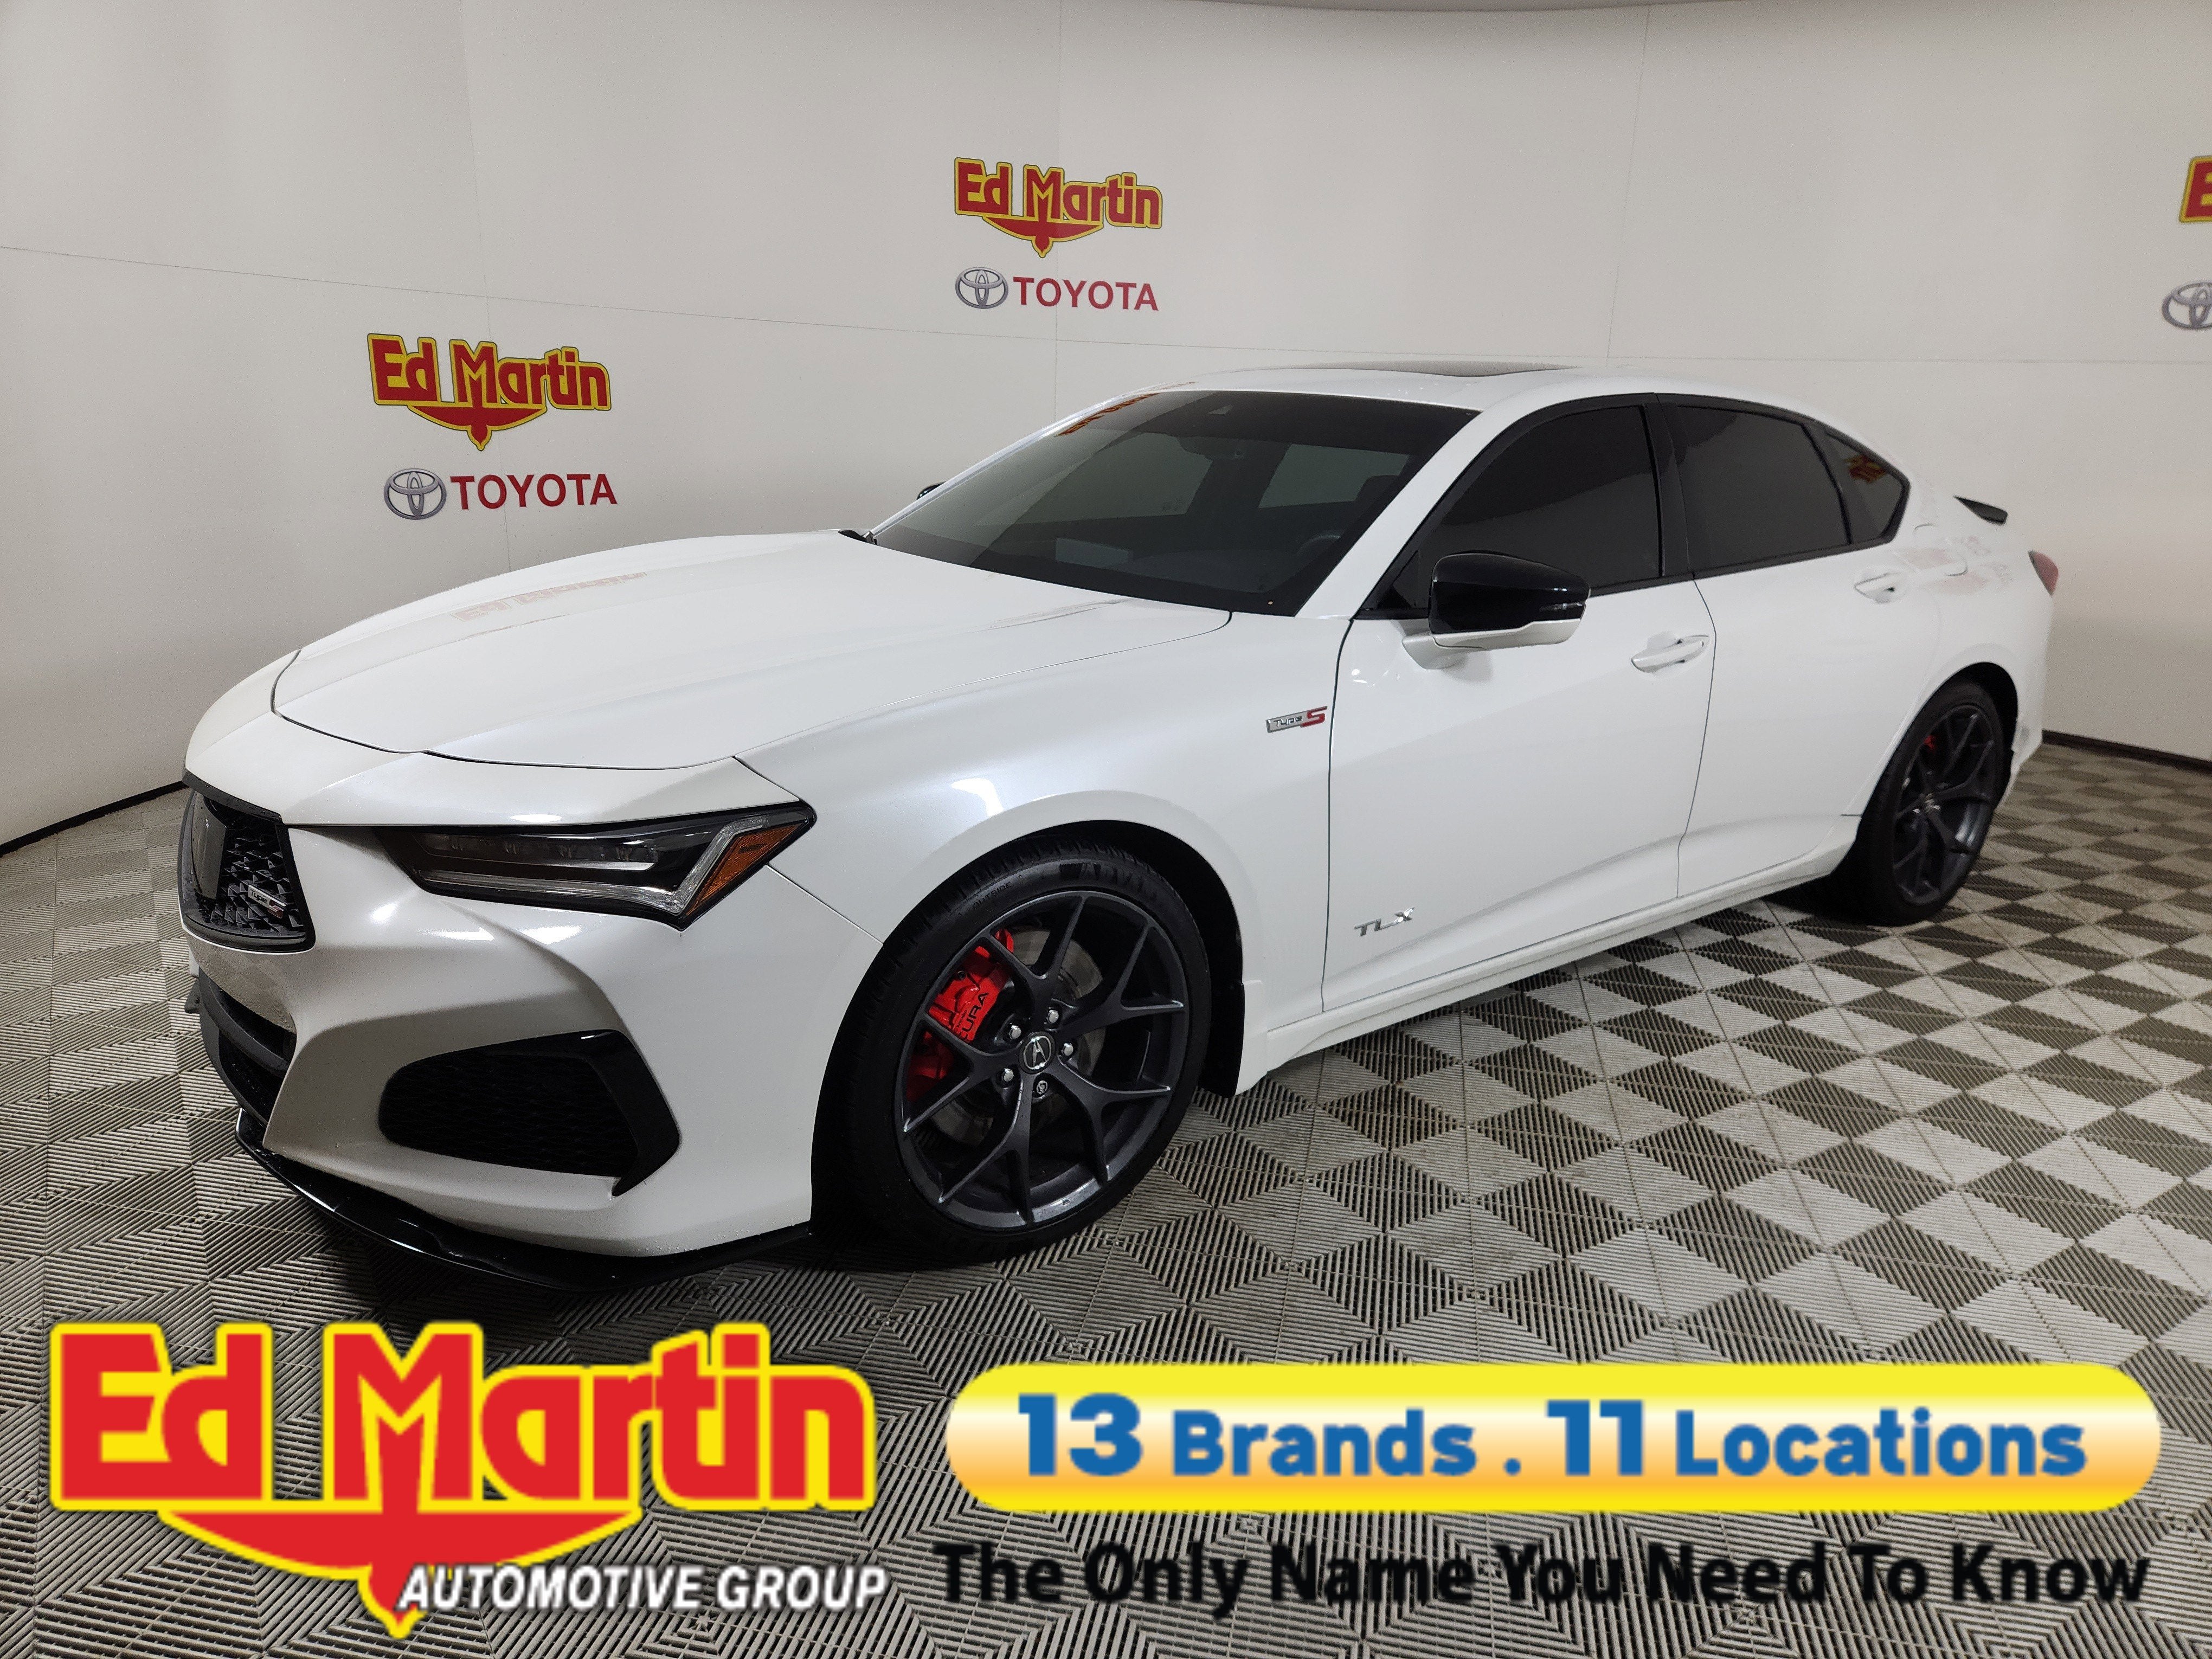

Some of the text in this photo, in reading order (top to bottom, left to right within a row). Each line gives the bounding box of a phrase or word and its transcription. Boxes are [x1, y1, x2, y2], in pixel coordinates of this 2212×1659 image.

[954, 158, 1162, 228] Ed Martin
[2179, 156, 2212, 223] E
[1013, 276, 1159, 311] TOYOTA
[368, 333, 611, 410] Ed Martin
[451, 473, 618, 510] TOYOTA
[1300, 706, 1327, 728] S
[1354, 907, 1414, 936] TLX
